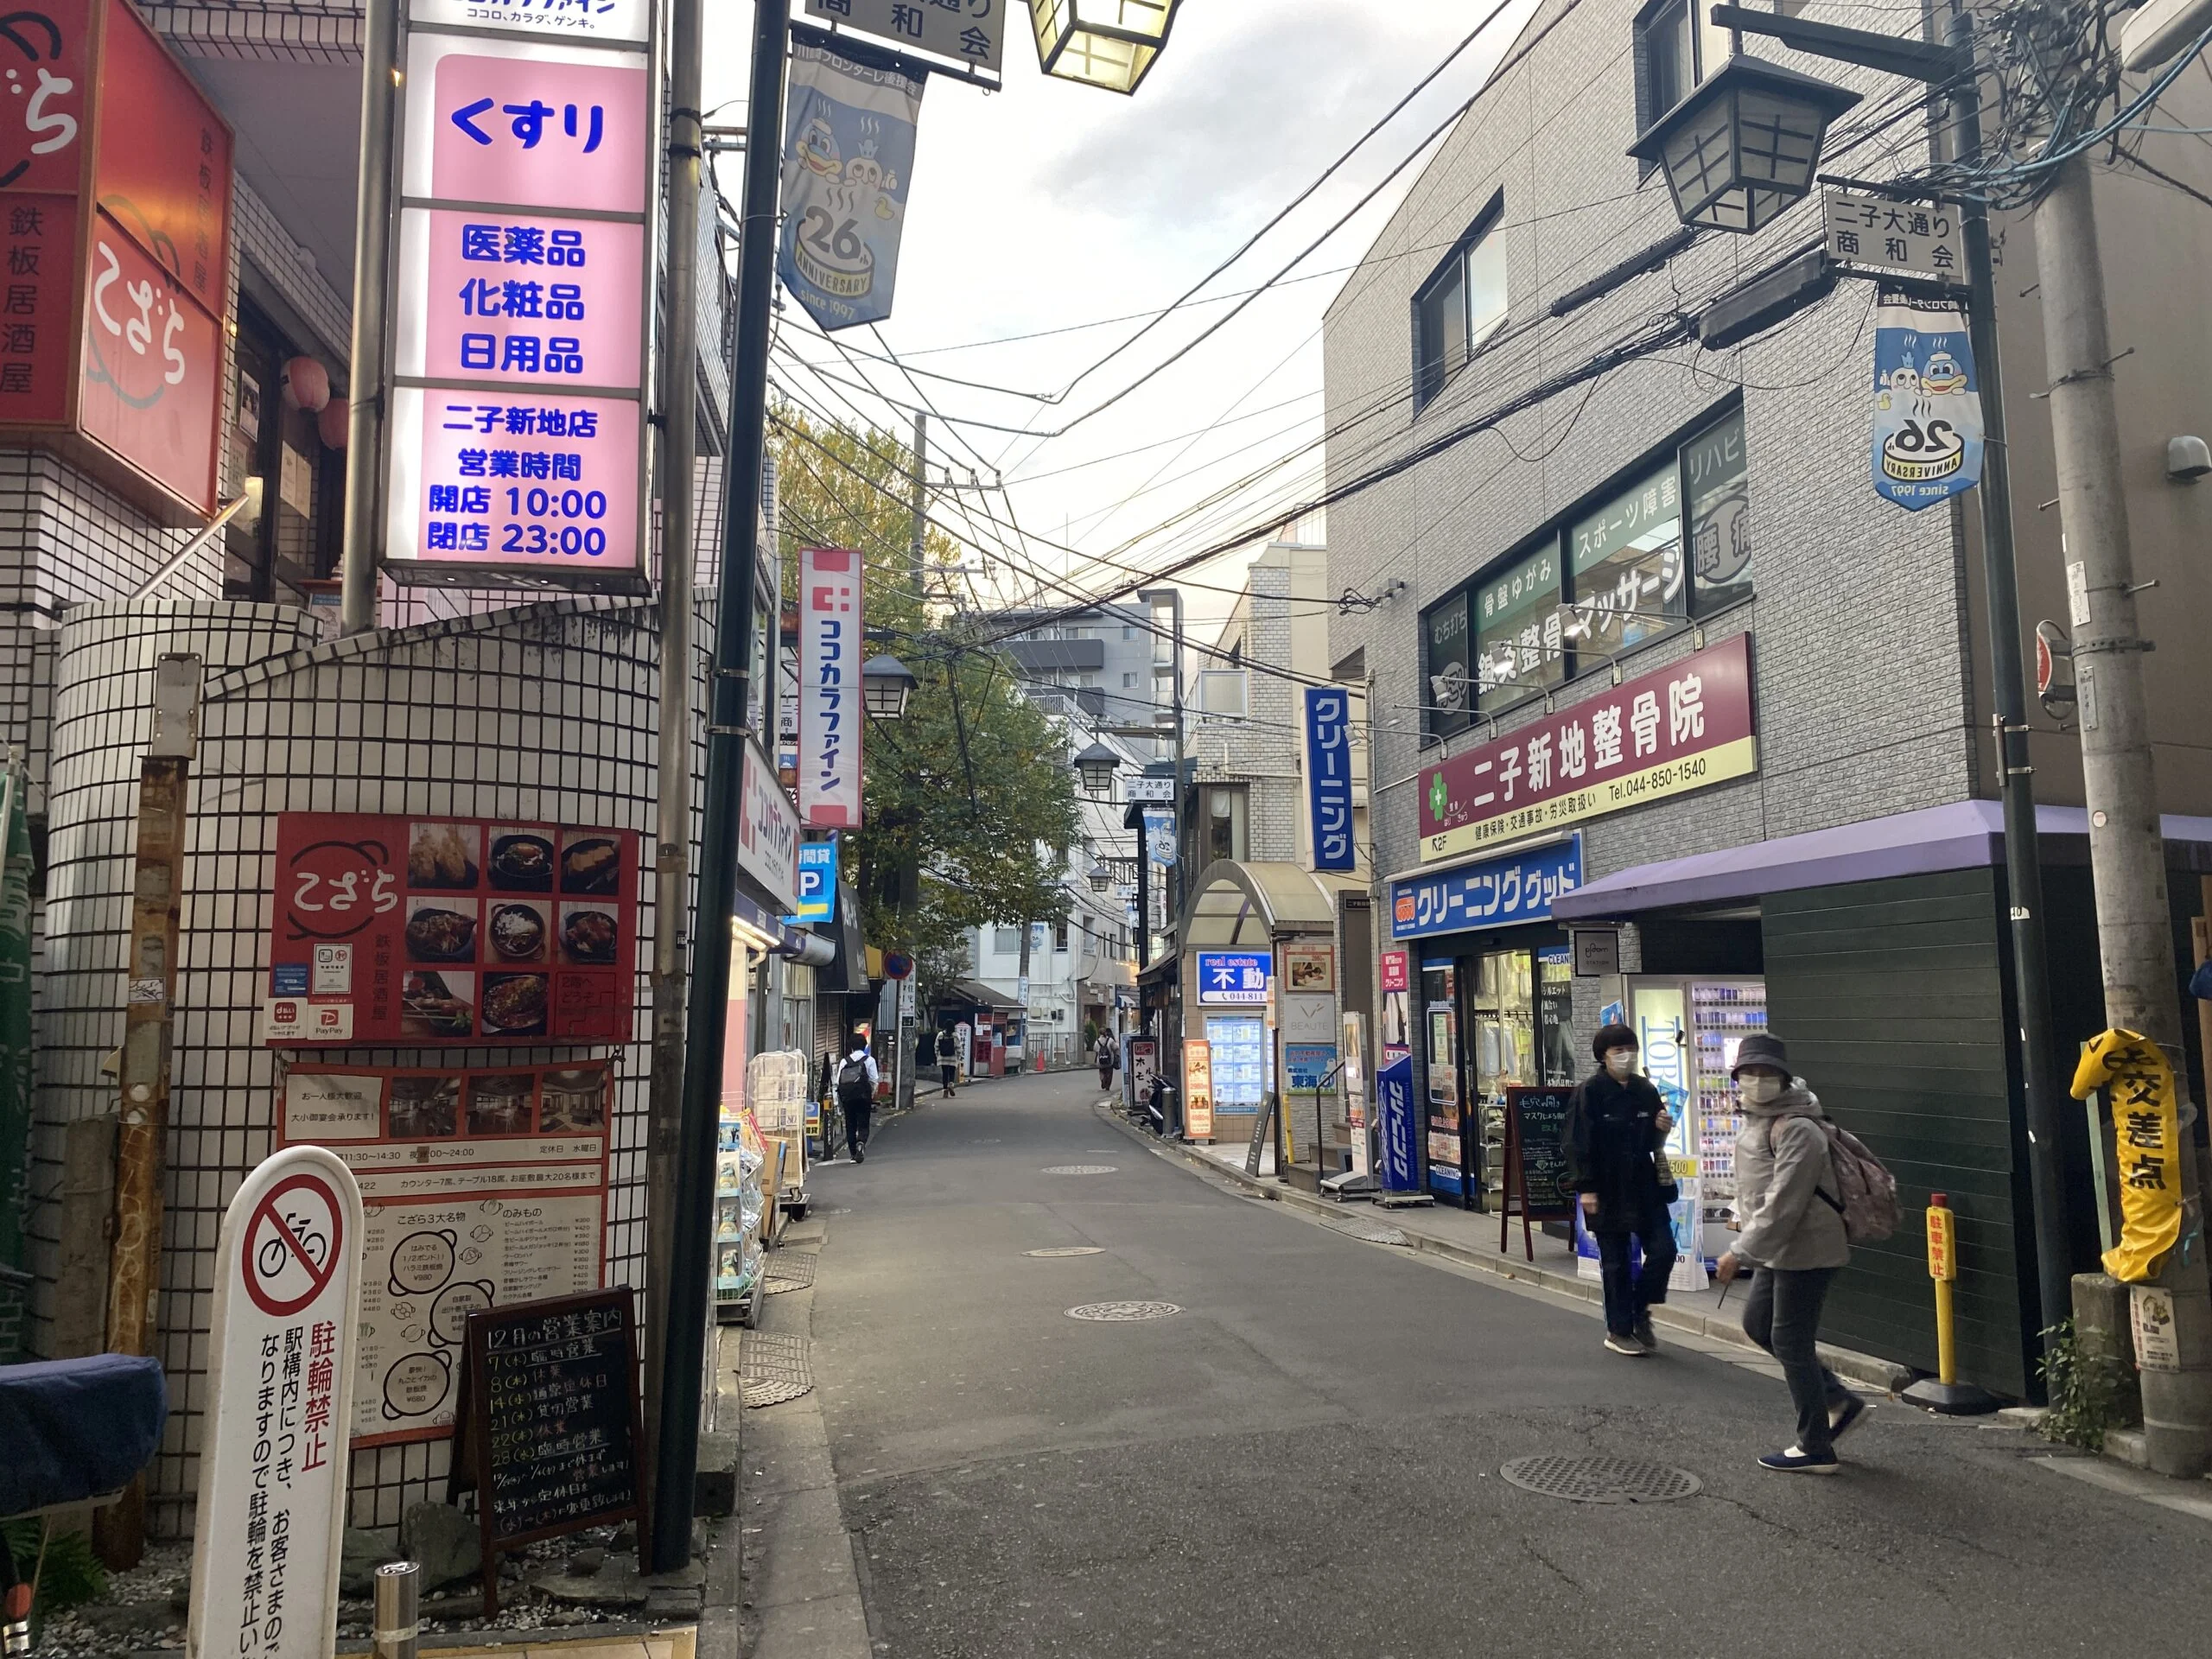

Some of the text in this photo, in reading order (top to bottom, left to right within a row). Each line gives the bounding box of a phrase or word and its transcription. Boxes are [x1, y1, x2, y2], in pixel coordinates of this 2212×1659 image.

[451, 97, 603, 154] くすり
[1835, 201, 1950, 238] 二子大通り
[461, 223, 586, 268] 医薬品
[1837, 231, 1954, 270] 商和会
[797, 250, 868, 295] ANNIVERSARY
[0, 207, 44, 395] 鉄板居酒屋
[459, 278, 586, 322] 化粧品
[800, 289, 855, 321] since 1997
[460, 334, 584, 375] 日用品
[442, 404, 598, 438] 二子新地店
[458, 448, 582, 481] 営業時間
[429, 484, 607, 519] 開店 10:00
[1579, 475, 1676, 559] スポーツ障害
[427, 522, 607, 556] 閉店 23:00
[1484, 558, 1552, 618] 骨盤ゆがみ
[1434, 610, 1466, 645] むち打ち
[820, 620, 842, 791] ココカラファイン
[1473, 673, 1707, 808] 二子新地整骨院
[1128, 790, 1171, 798] 商和会
[1316, 697, 1347, 859] クリーニング
[1476, 762, 1707, 842] 健康保険・交通事故・労災取扱い Tel.044-850-1540
[1437, 836, 1447, 851] 2F
[800, 871, 821, 896] P
[1205, 957, 1258, 967] real estate
[1212, 968, 1264, 990] 不動
[315, 1027, 343, 1035] PayPay
[539, 1145, 564, 1154] 定休日
[573, 1143, 597, 1154] 水曜日
[1389, 1080, 1408, 1182] クリーニング
[2123, 1071, 2167, 1191] 交差点
[1669, 1160, 1688, 1173] 500
[502, 1208, 543, 1218] のみもの
[1929, 1215, 1944, 1276] 駐車禁止
[275, 1325, 303, 1490] 駅構内につき、
[302, 1320, 337, 1473] 駐輪禁止
[239, 1333, 279, 1659] なりますので駐輪を禁止い
